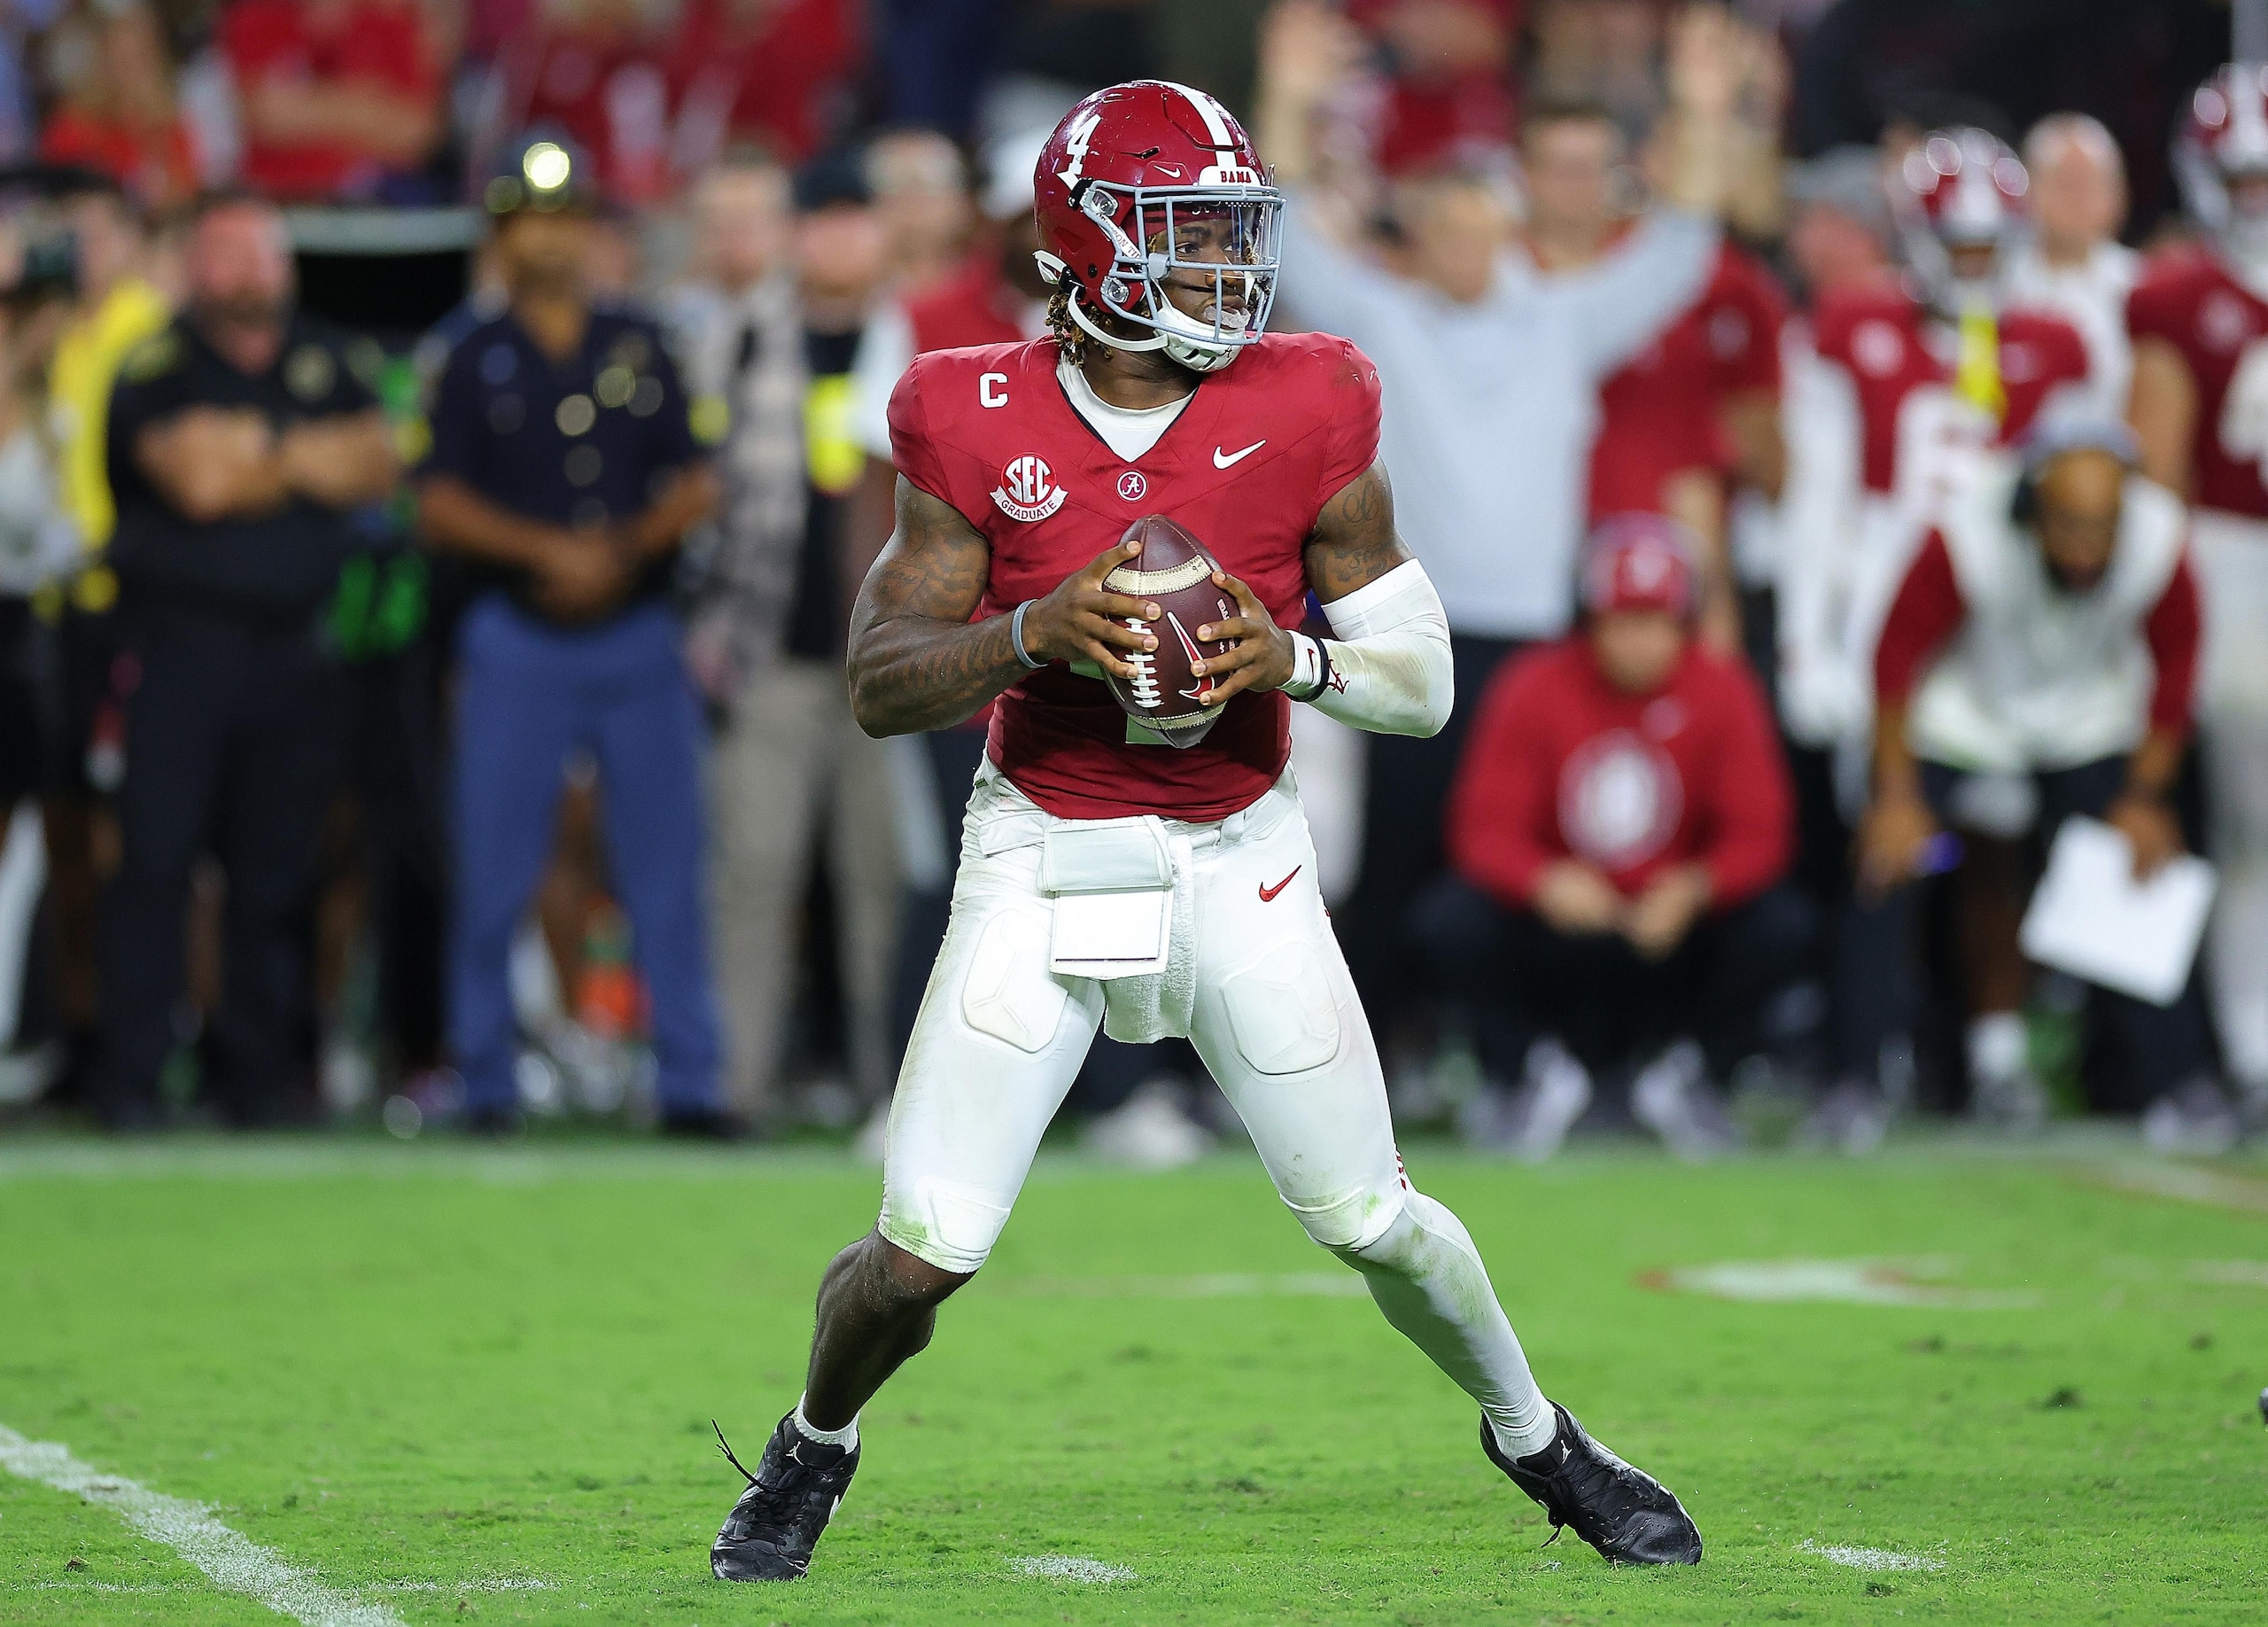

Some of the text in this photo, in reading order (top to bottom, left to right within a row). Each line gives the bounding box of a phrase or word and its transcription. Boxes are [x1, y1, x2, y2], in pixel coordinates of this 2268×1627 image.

[1067, 114, 1102, 175] 4
[1220, 171, 1252, 183] BAMA
[979, 372, 1008, 409] C
[1005, 455, 1052, 503] SEC
[1001, 499, 1057, 520] GRADUATE
